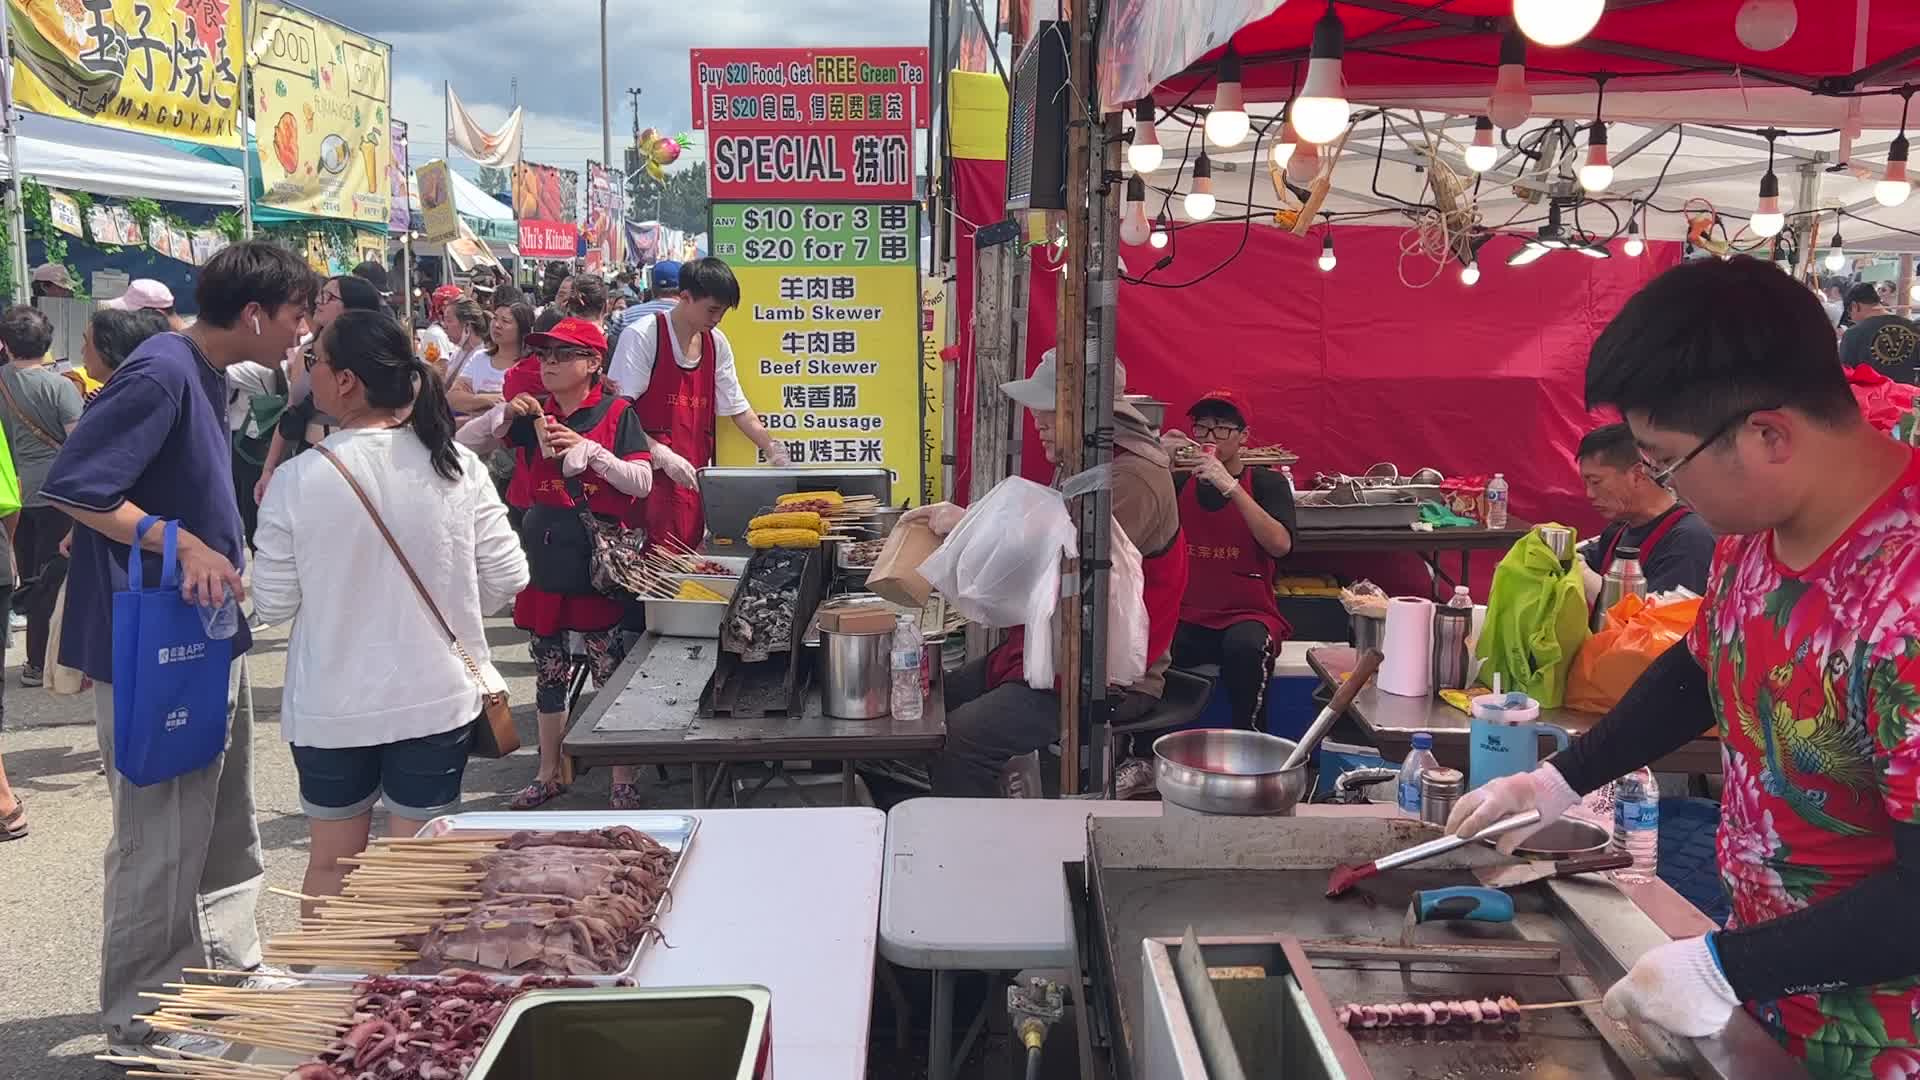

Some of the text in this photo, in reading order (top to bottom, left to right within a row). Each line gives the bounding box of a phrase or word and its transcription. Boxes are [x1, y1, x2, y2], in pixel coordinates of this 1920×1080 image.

[699, 57, 922, 87] Buy $20 Food, Get FREE Green Tea
[77, 86, 234, 137] TAMAGOYAKI
[716, 137, 906, 183] SPECIAL 特价
[714, 205, 907, 231] ANY $10 for 3 串
[519, 225, 544, 250] Nhi's
[744, 238, 794, 261] $20
[803, 237, 844, 260] for
[854, 238, 869, 259] 7
[880, 235, 907, 260] 串
[780, 276, 855, 300] 羊肉串
[754, 305, 882, 320] Lamb Skewer
[781, 331, 856, 355] 牛肉串
[760, 359, 878, 375] Beef Skewer
[783, 385, 857, 409] 烤香肠
[759, 413, 882, 431] BBQ Sausage
[758, 440, 882, 463] 油烤玉米
